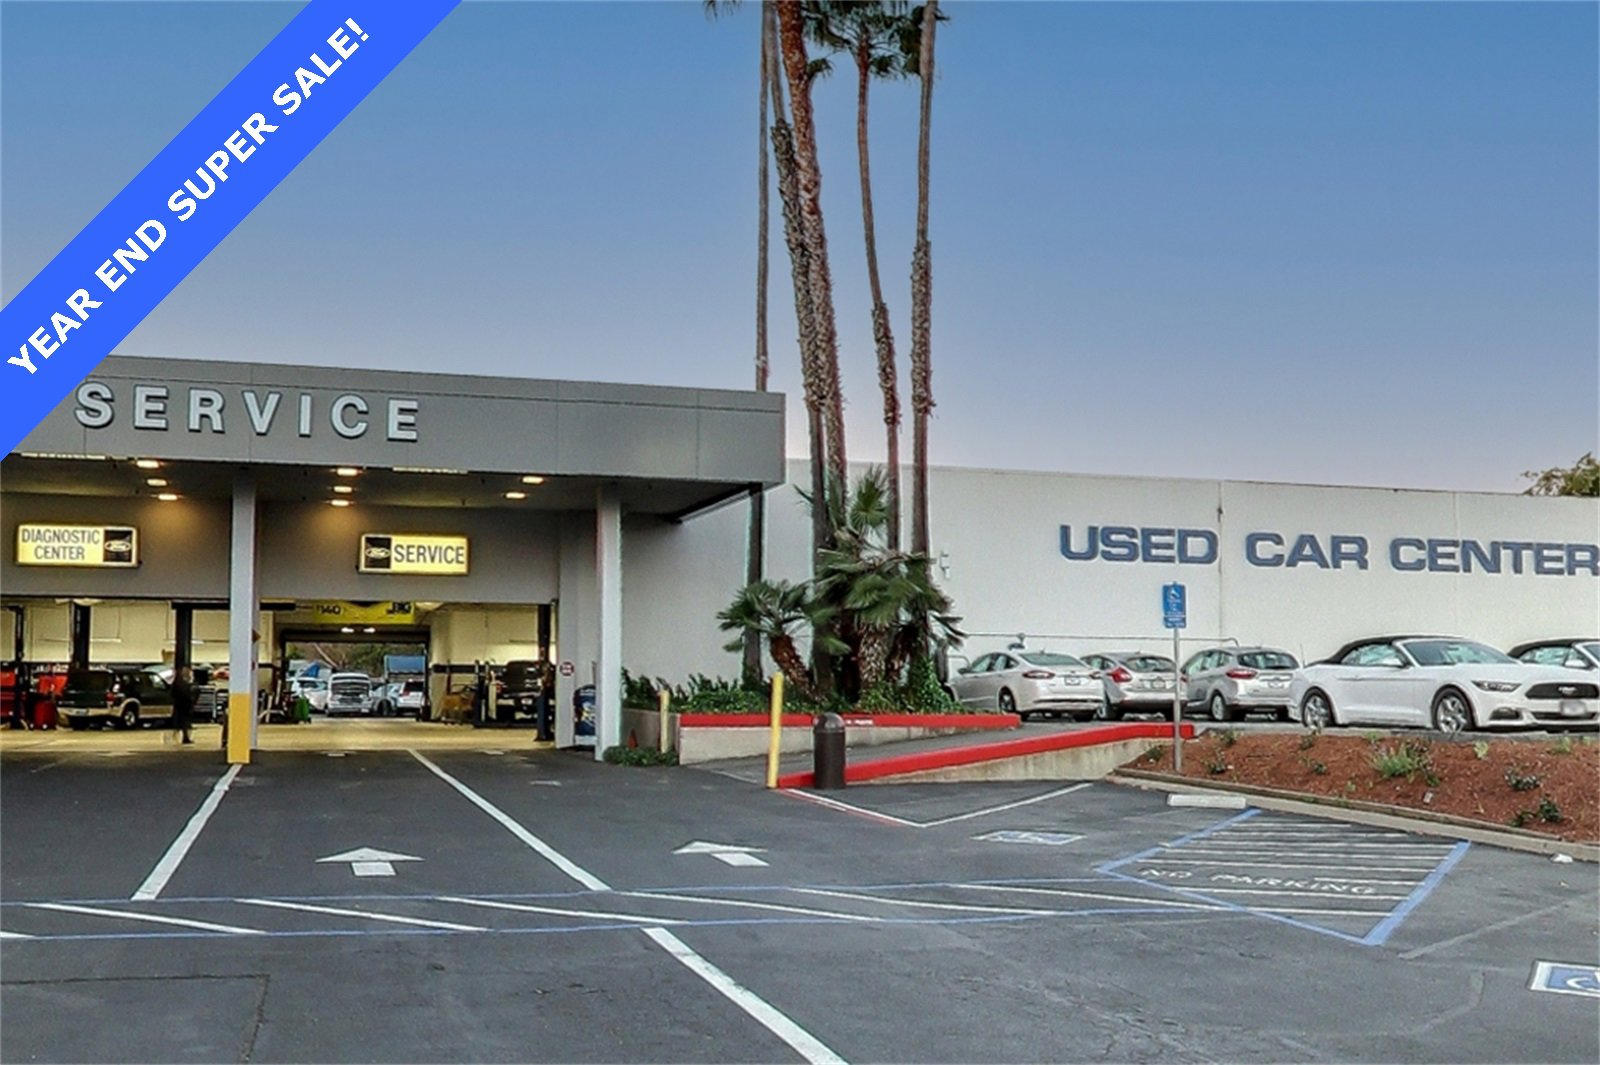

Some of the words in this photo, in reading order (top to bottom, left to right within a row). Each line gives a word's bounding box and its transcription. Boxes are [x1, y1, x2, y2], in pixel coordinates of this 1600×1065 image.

[75, 382, 419, 442] SERVICE
[21, 528, 101, 544] DIAGNOSTIC
[34, 545, 85, 560] CENTER
[394, 544, 465, 565] SERVICE
[1059, 524, 1219, 565] USED
[1245, 532, 1369, 570] CAR
[1389, 537, 1600, 577] CENTER
[1139, 868, 1192, 879] NO
[1211, 873, 1375, 894] PARKING
